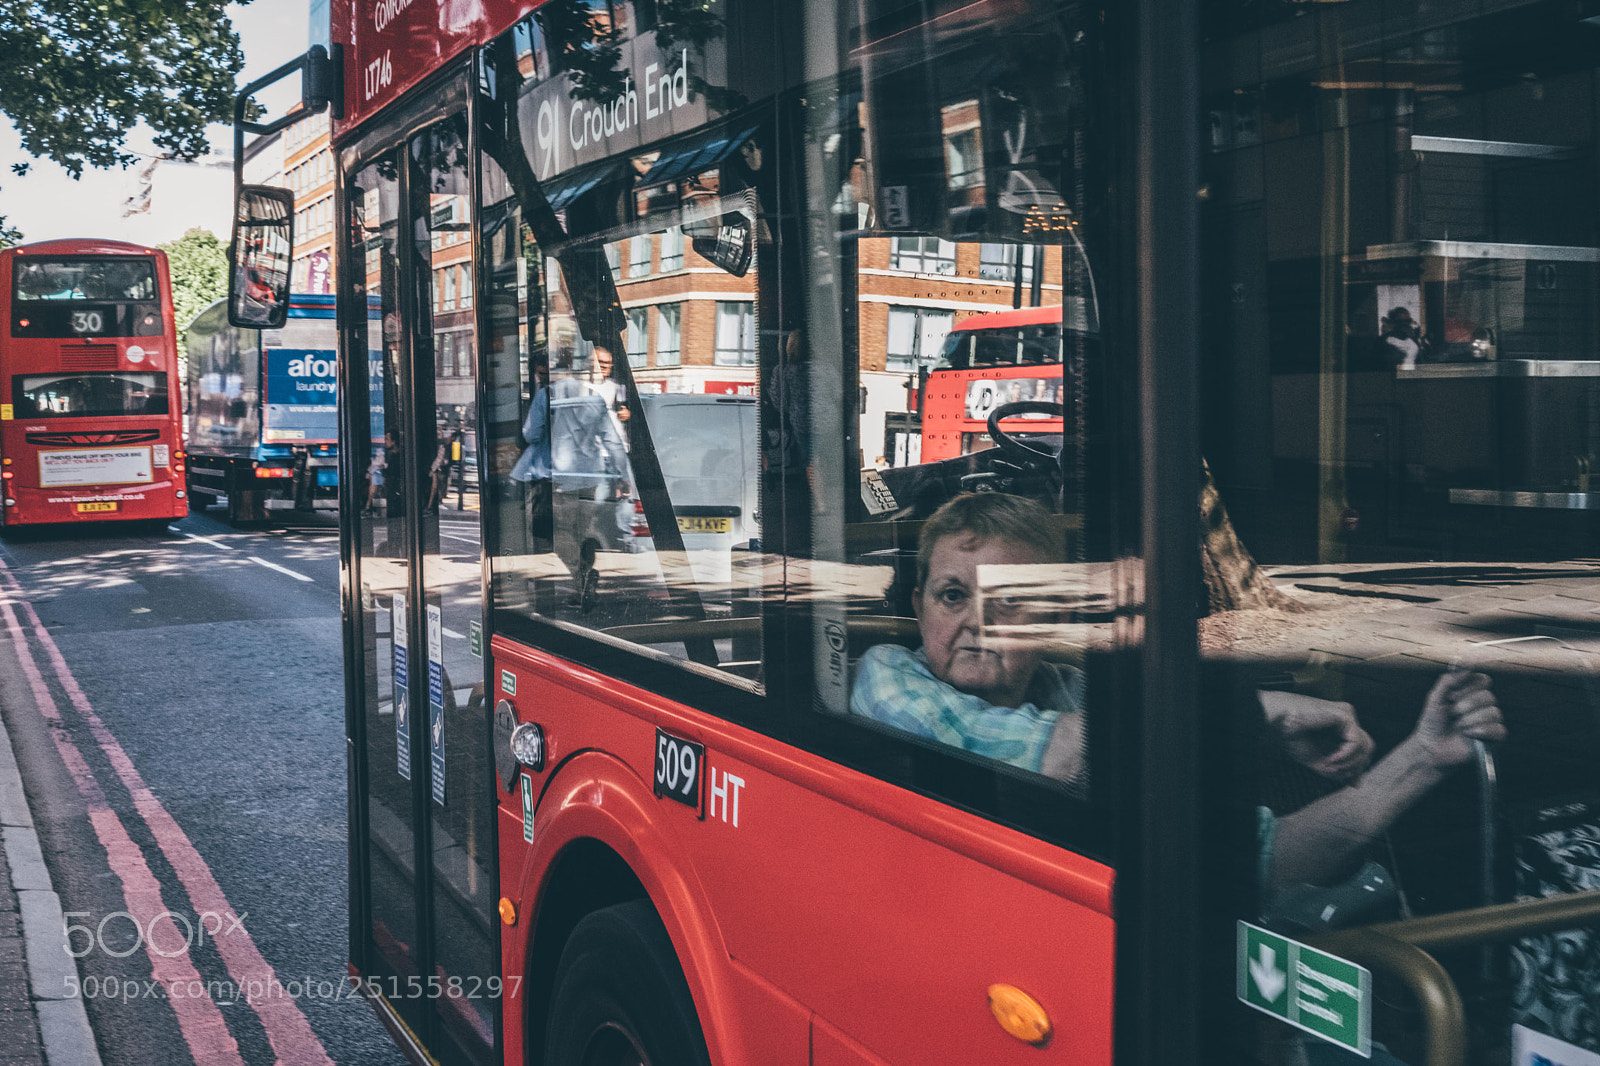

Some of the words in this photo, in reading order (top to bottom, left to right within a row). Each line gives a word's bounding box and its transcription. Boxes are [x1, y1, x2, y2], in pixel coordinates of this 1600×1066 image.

[365, 49, 392, 101] LT746
[537, 95, 560, 182] 91
[569, 76, 638, 151] Crouch
[645, 48, 688, 120] End
[73, 312, 102, 332] 30
[296, 380, 337, 393] laundry
[656, 734, 696, 796] 509
[710, 766, 745, 828] HT
